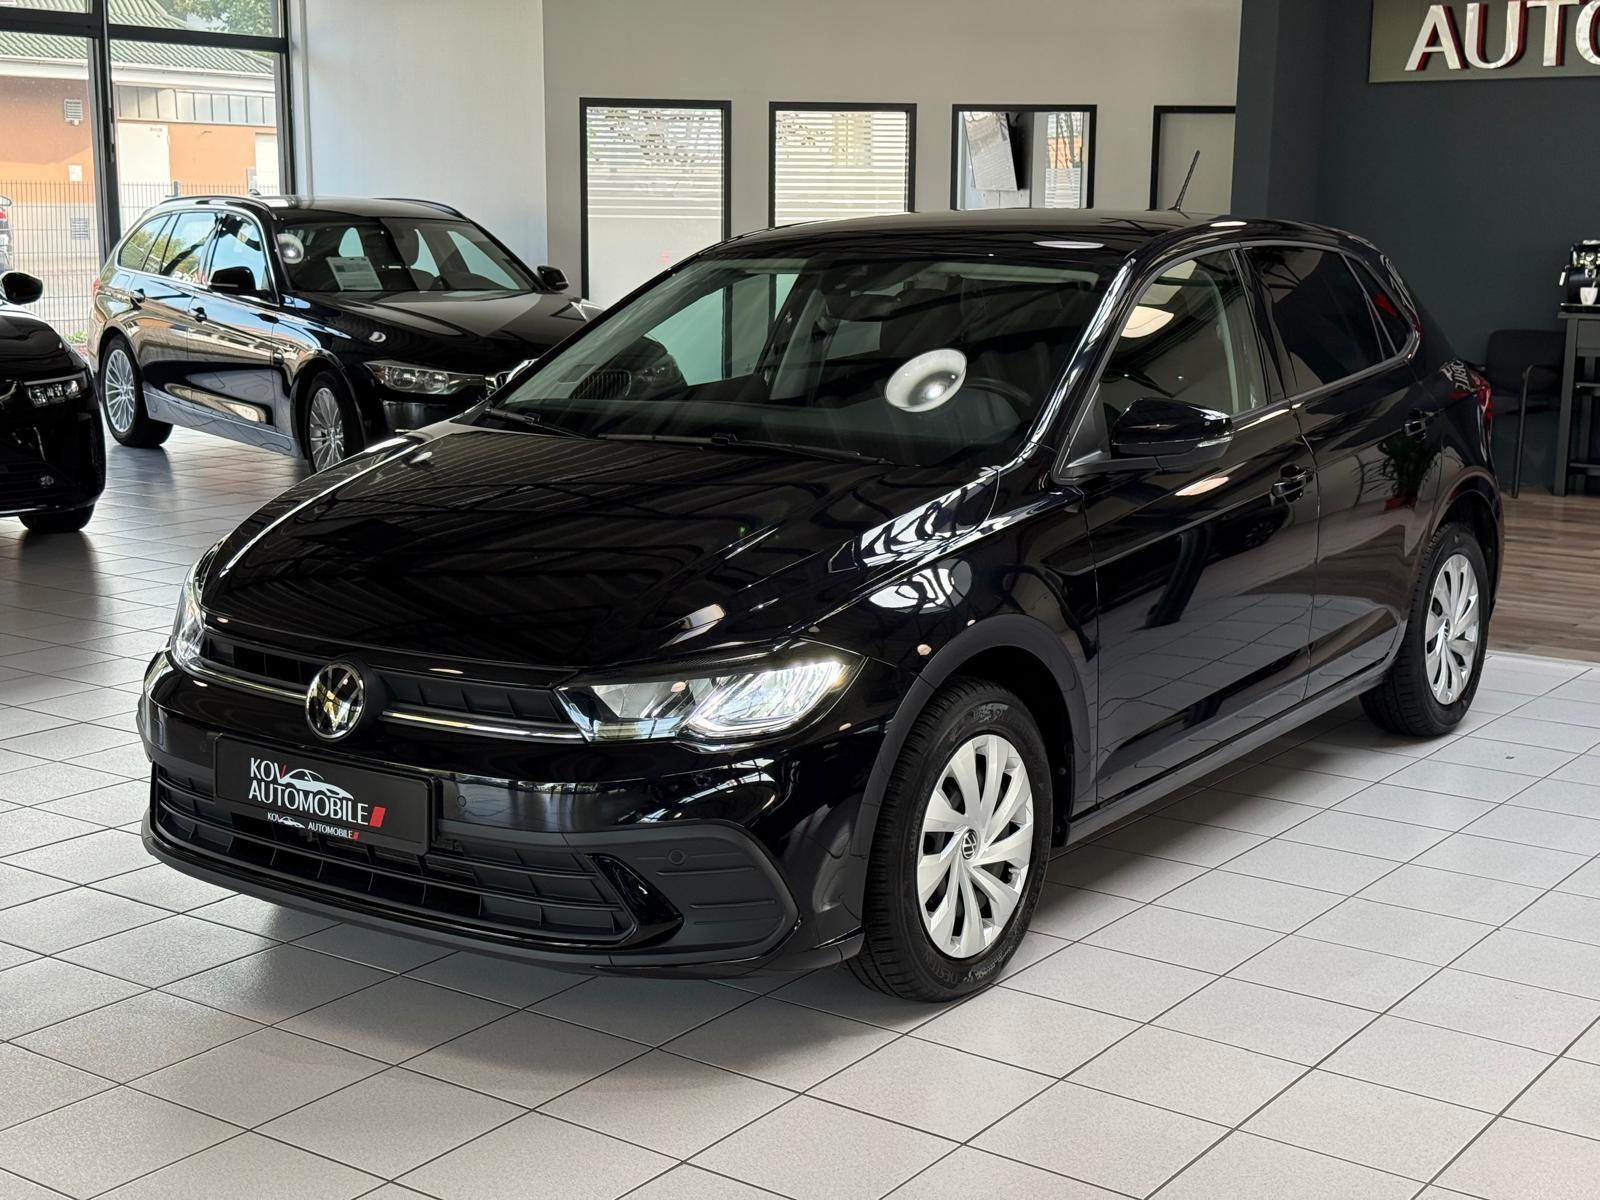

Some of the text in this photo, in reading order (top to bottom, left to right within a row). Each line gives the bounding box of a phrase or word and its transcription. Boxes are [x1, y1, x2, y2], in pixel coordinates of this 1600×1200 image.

[250, 757, 287, 784] KOV
[248, 780, 369, 826] AUTOMOBILE
[308, 821, 353, 840] AUTOMOBILE
